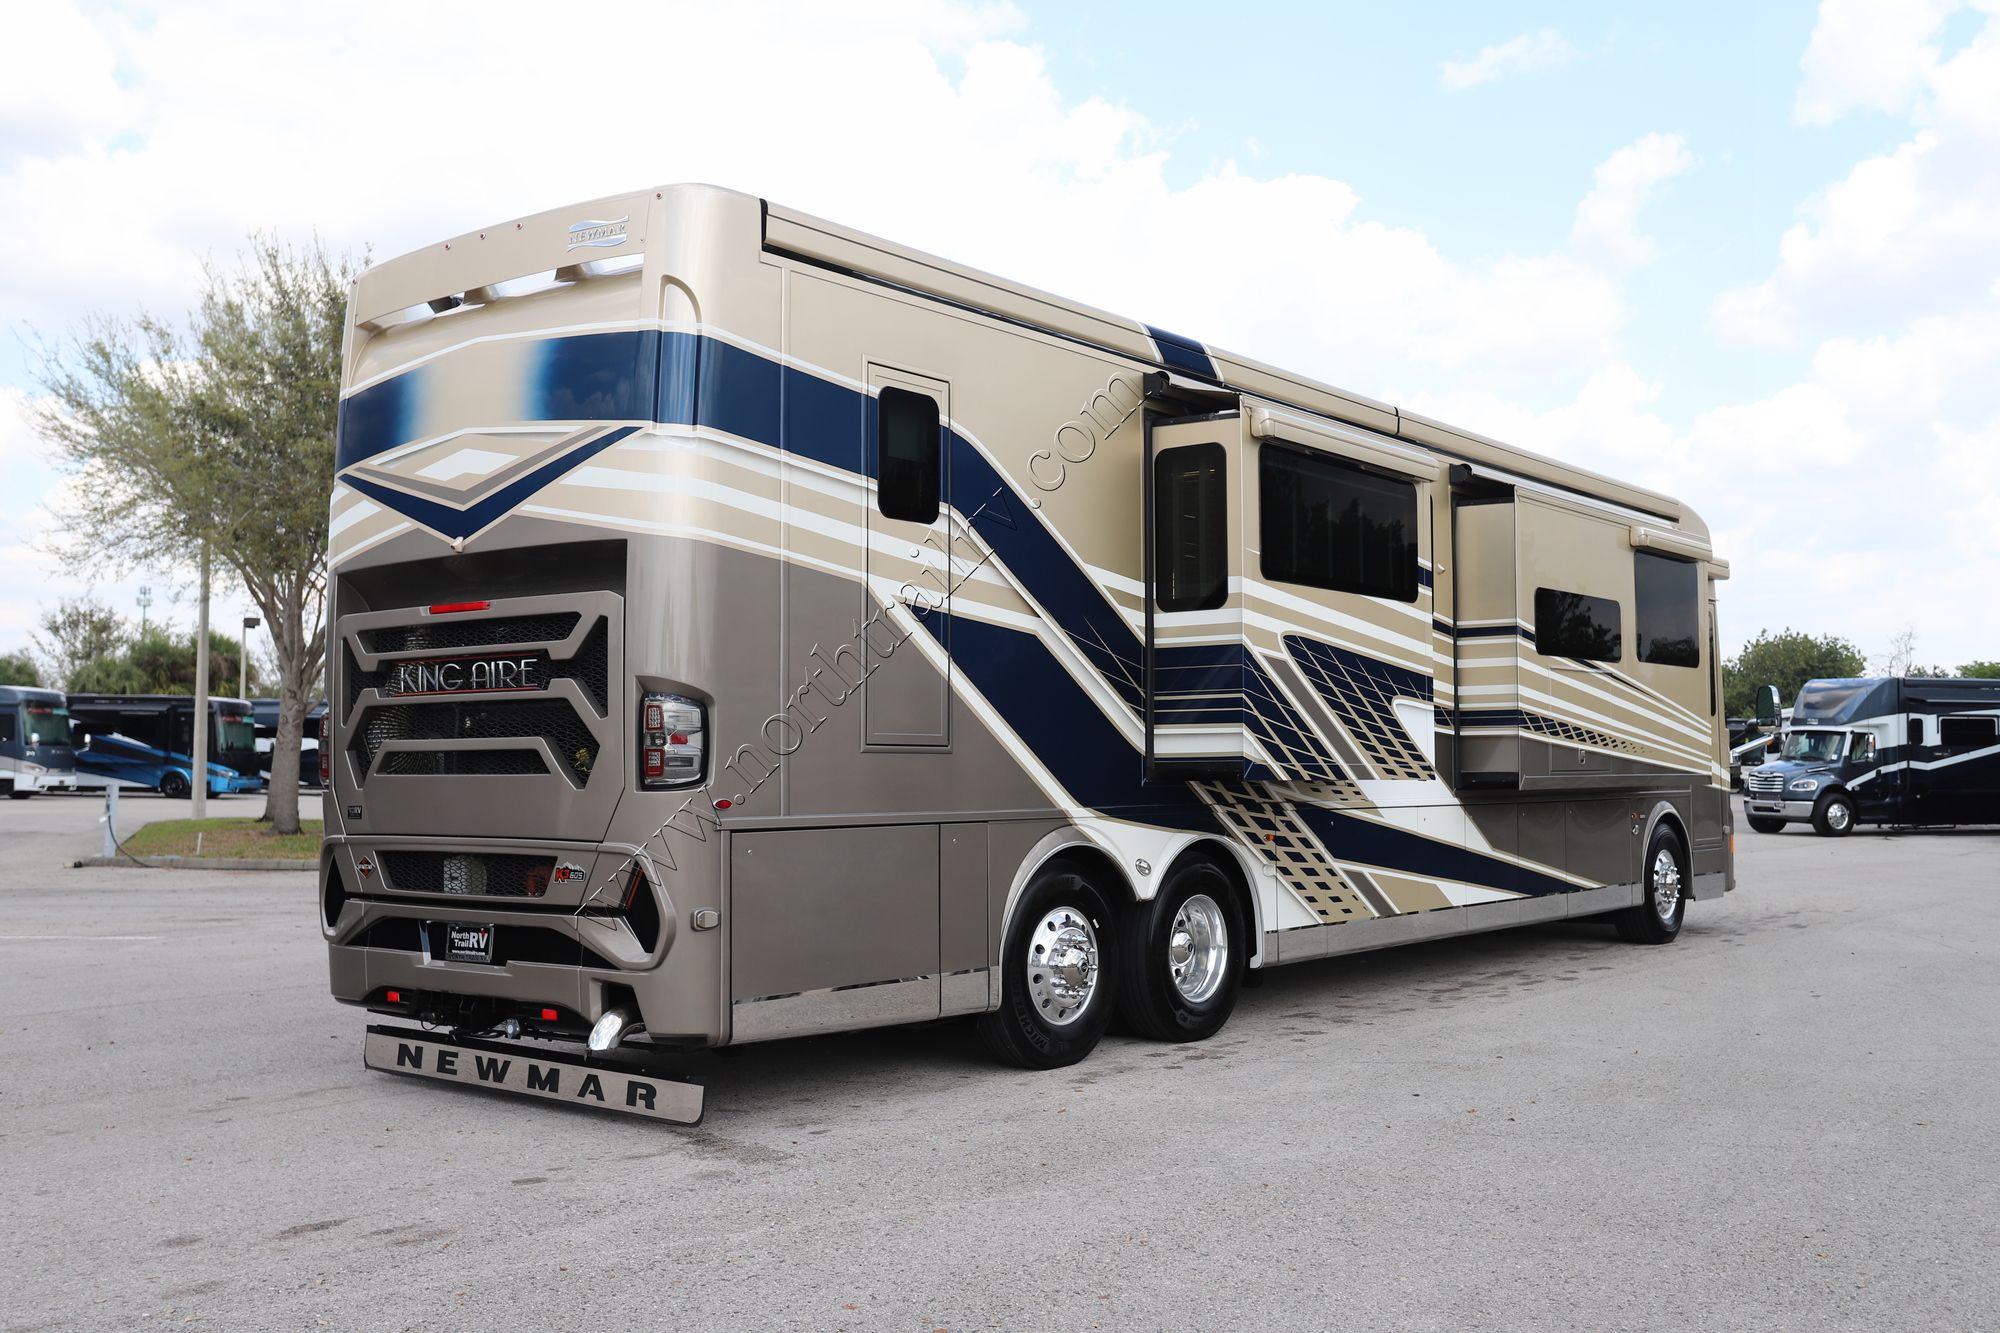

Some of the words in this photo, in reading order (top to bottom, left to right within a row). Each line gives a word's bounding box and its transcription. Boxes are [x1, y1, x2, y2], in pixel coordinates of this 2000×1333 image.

[569, 224, 626, 245] NEWMAR
[400, 663, 463, 693] KING
[470, 658, 538, 689] AIRE
[451, 931, 470, 940] North
[454, 939, 470, 948] Trail
[469, 932, 489, 949] RV
[396, 1043, 658, 1111] NEWMAR
